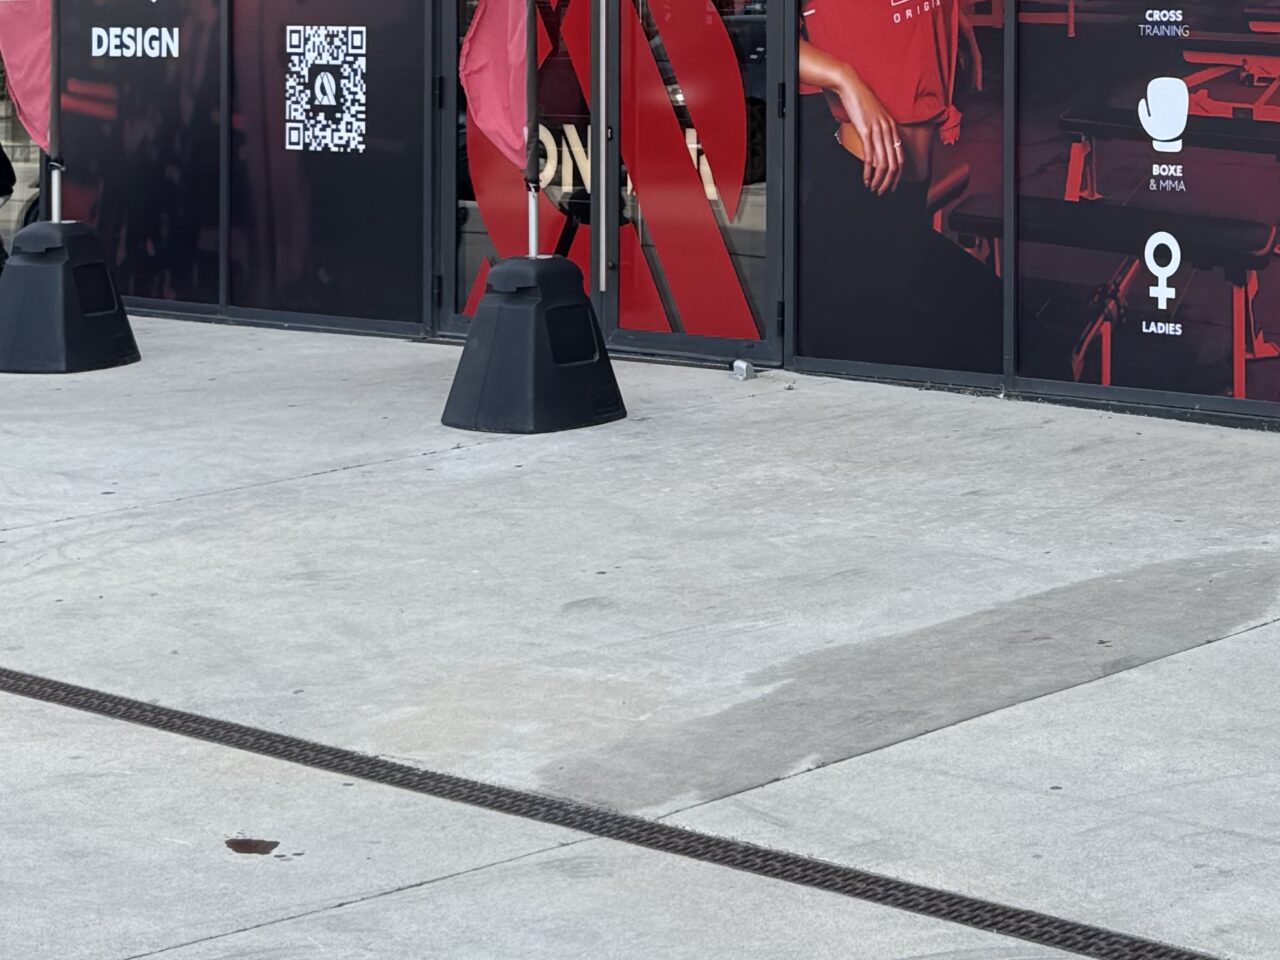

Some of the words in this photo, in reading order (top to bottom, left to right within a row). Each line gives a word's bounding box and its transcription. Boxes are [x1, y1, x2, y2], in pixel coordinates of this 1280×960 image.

[1145, 10, 1183, 22] CROSS
[1138, 25, 1190, 37] TRAINING
[91, 27, 180, 58] DESIGN
[1152, 164, 1183, 177] BOXE
[1149, 179, 1157, 191] &
[1159, 180, 1186, 192] MMA
[1142, 321, 1183, 335] LADIES
